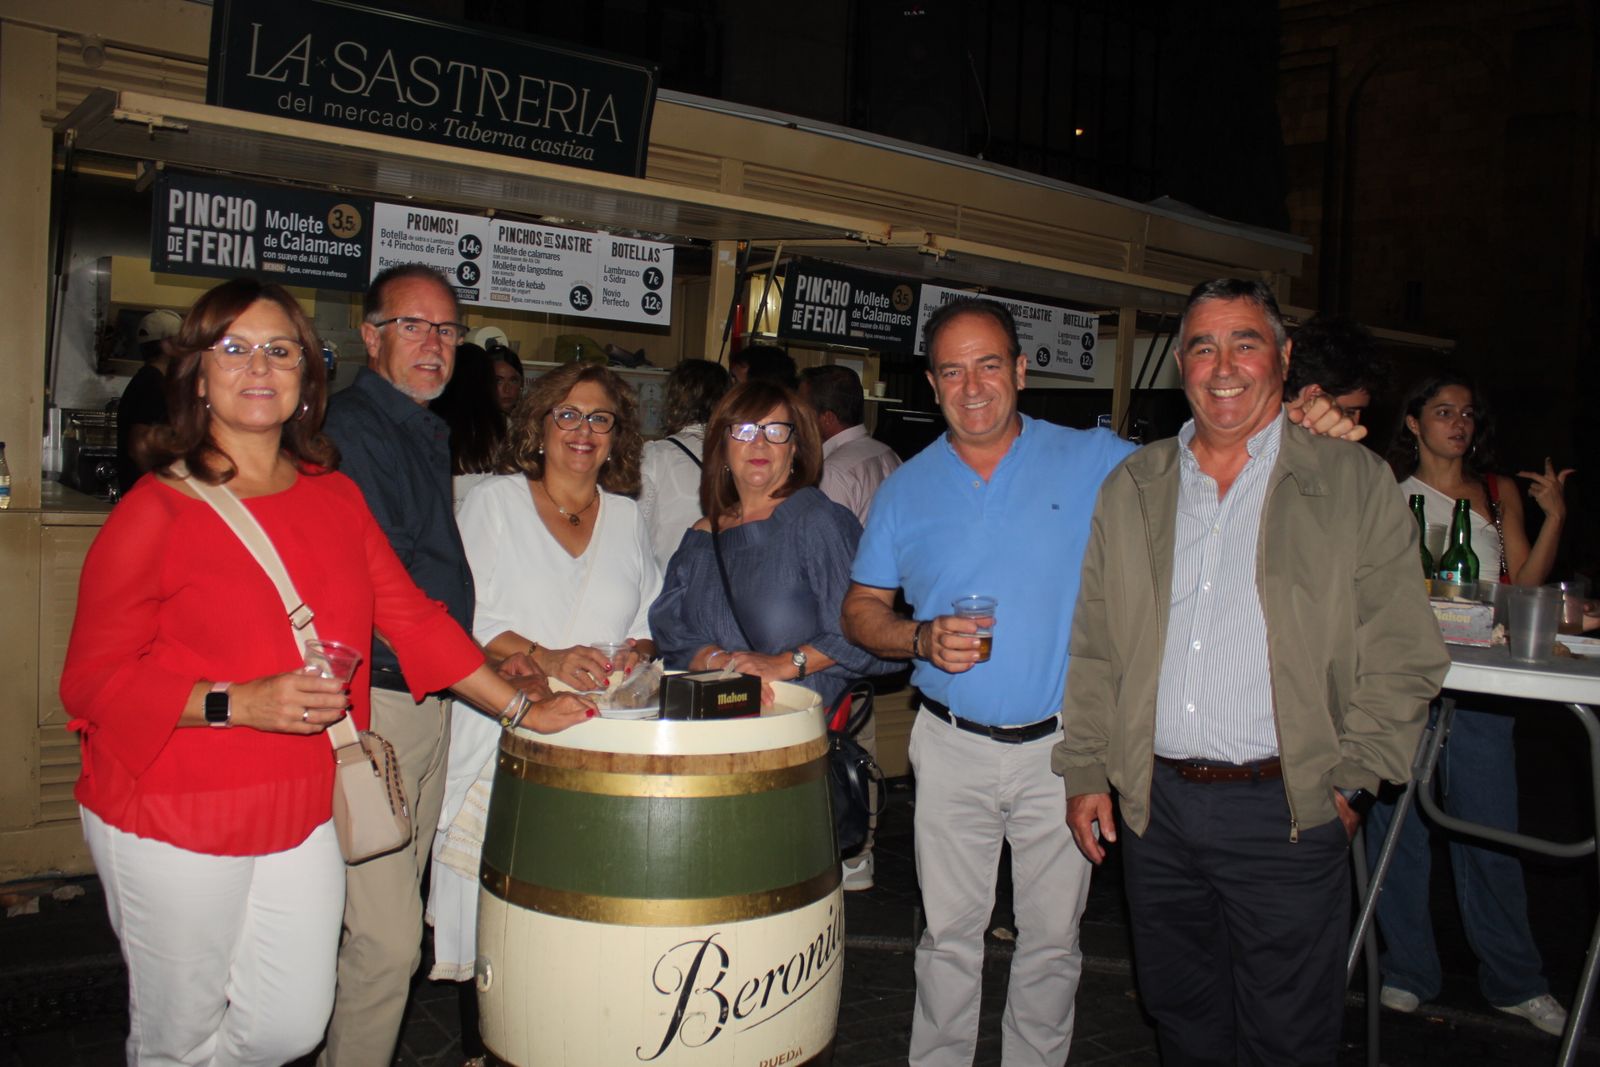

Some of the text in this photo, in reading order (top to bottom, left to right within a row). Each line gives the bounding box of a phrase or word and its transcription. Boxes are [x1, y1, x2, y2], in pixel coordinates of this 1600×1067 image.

[246, 22, 624, 142] LA SASTRERIA
[277, 92, 596, 161] del mercado Taberna castiza
[168, 188, 258, 232] PINCHO
[265, 210, 324, 234] Mollete
[407, 212, 459, 236] PROMOS!
[381, 228, 408, 240] Botella
[499, 226, 542, 246] PINCHOS
[555, 234, 592, 254] SASTRE
[167, 230, 256, 270] DE FERIA
[264, 231, 362, 258] de Calamares
[387, 240, 392, 248] 4
[394, 240, 424, 252] Pinchos
[426, 244, 435, 254] de
[436, 245, 454, 256] Feria
[461, 238, 480, 255] 14€
[493, 244, 560, 262] Mollete de calamares
[611, 242, 660, 262] BOTELLAS
[263, 251, 276, 259] con
[277, 252, 298, 262] suave
[299, 252, 308, 263] de
[462, 266, 476, 280] 8€
[492, 260, 564, 278] Mollete de langostinos
[604, 264, 640, 278] Lambrusco
[491, 276, 546, 290] Mollete de kebab
[609, 274, 626, 284] Sidra
[648, 271, 659, 285] 7€
[602, 288, 621, 298] Novio
[795, 274, 850, 307] PINCHO
[854, 290, 890, 308] Mollete
[602, 296, 630, 308] Perfecto
[644, 296, 661, 310] 12€
[792, 304, 847, 336] DE FERIA
[852, 306, 912, 326] de Calamares
[1029, 308, 1052, 322] SASTRE
[1063, 313, 1093, 329] BOTELLAS
[718, 692, 748, 705] Mahou
